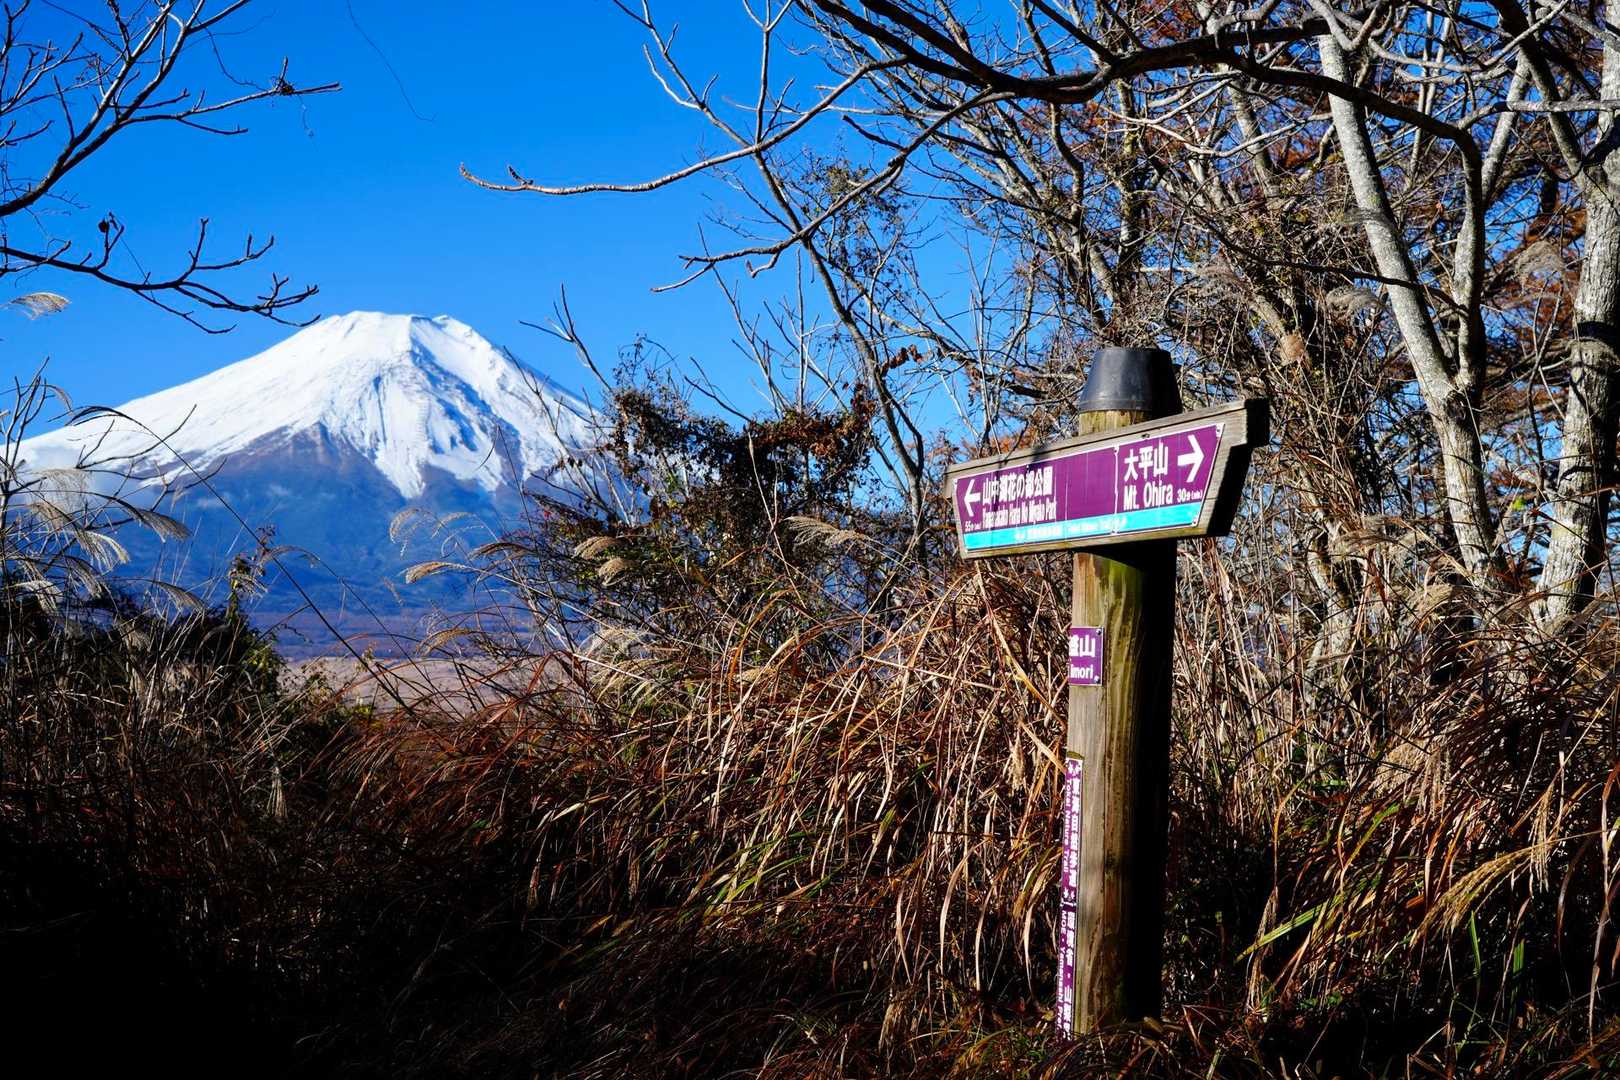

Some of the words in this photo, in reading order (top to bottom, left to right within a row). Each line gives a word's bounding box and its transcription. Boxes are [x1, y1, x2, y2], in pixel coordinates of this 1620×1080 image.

[1124, 441, 1168, 482] 大平山
[1123, 485, 1139, 511] Mt.
[1143, 481, 1173, 506] Ohira
